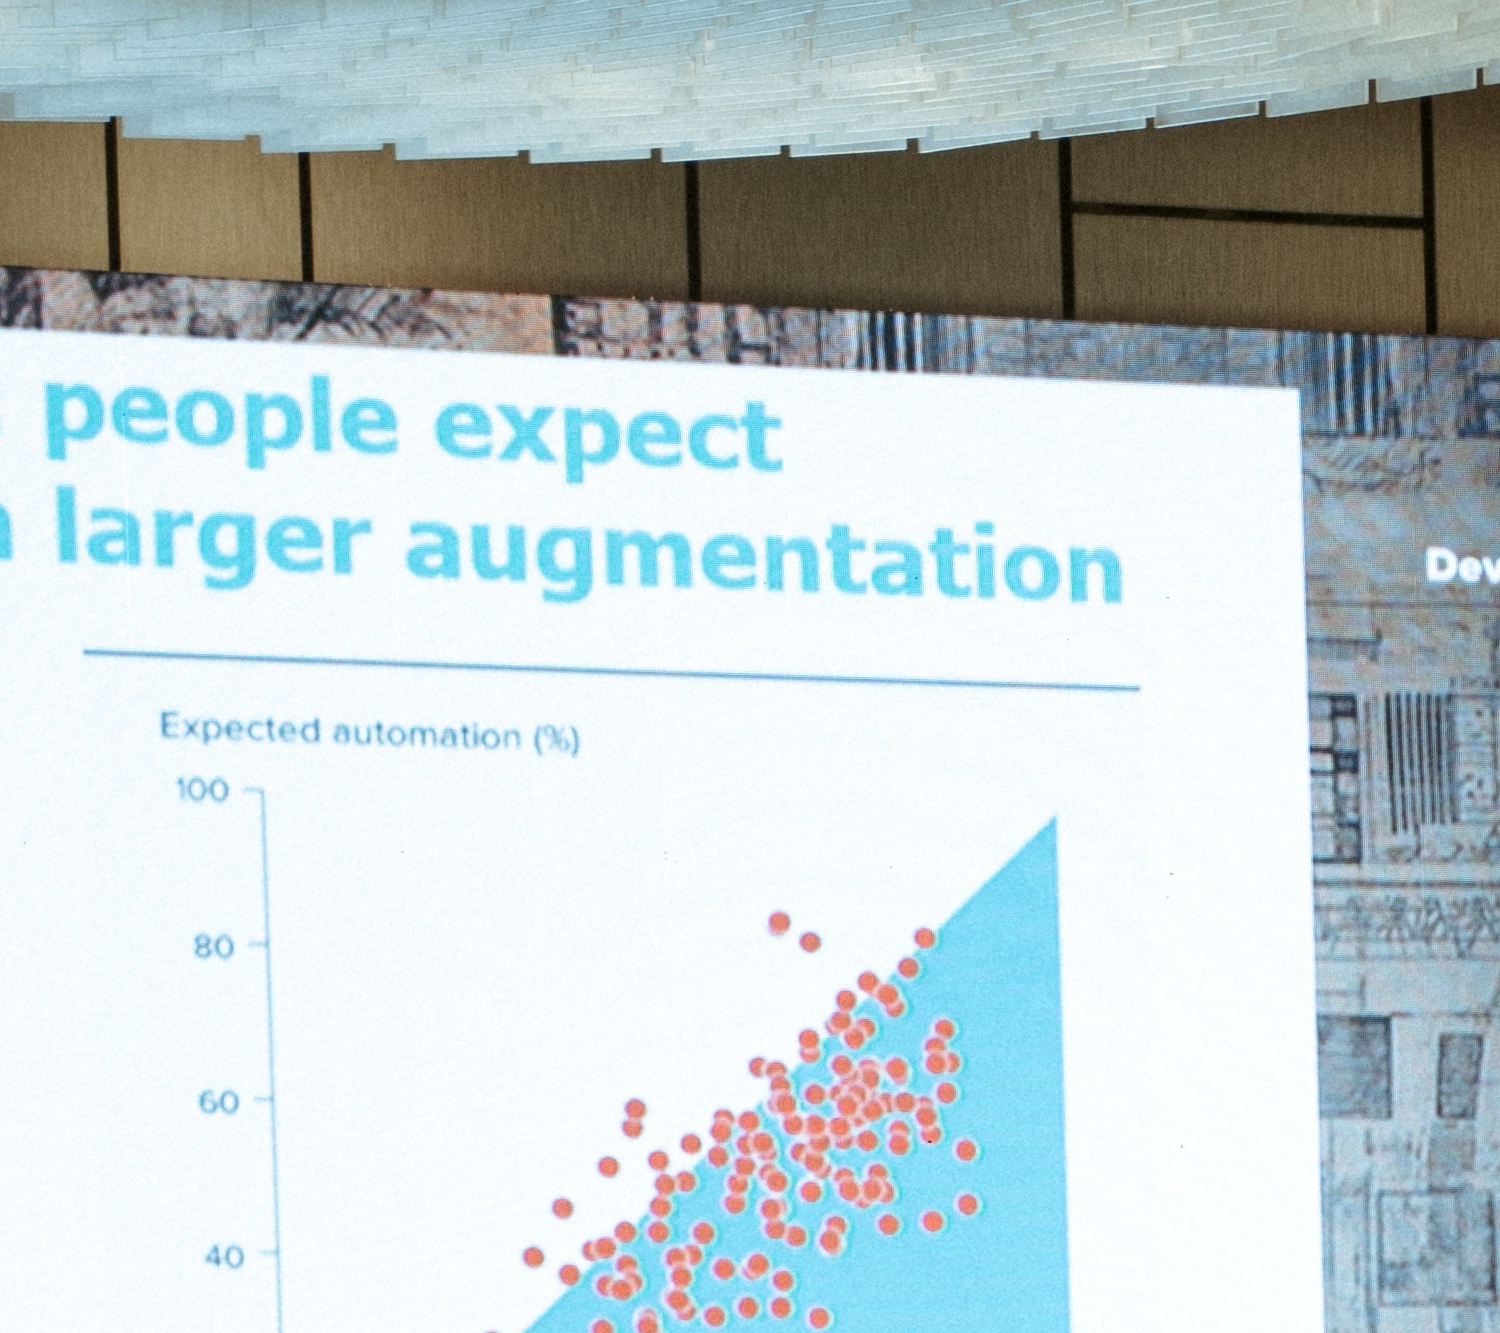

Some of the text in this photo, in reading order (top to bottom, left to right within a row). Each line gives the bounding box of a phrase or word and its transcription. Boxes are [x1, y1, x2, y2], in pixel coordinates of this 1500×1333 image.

[46, 376, 398, 470] people
[437, 400, 783, 484] expect
[48, 486, 373, 592] larger
[407, 513, 1124, 605] augmentation
[161, 710, 581, 758] Expected automation (%)
[177, 776, 231, 804] 100
[195, 934, 236, 961] 80
[199, 1090, 241, 1116] 60
[206, 1245, 246, 1270] 40
